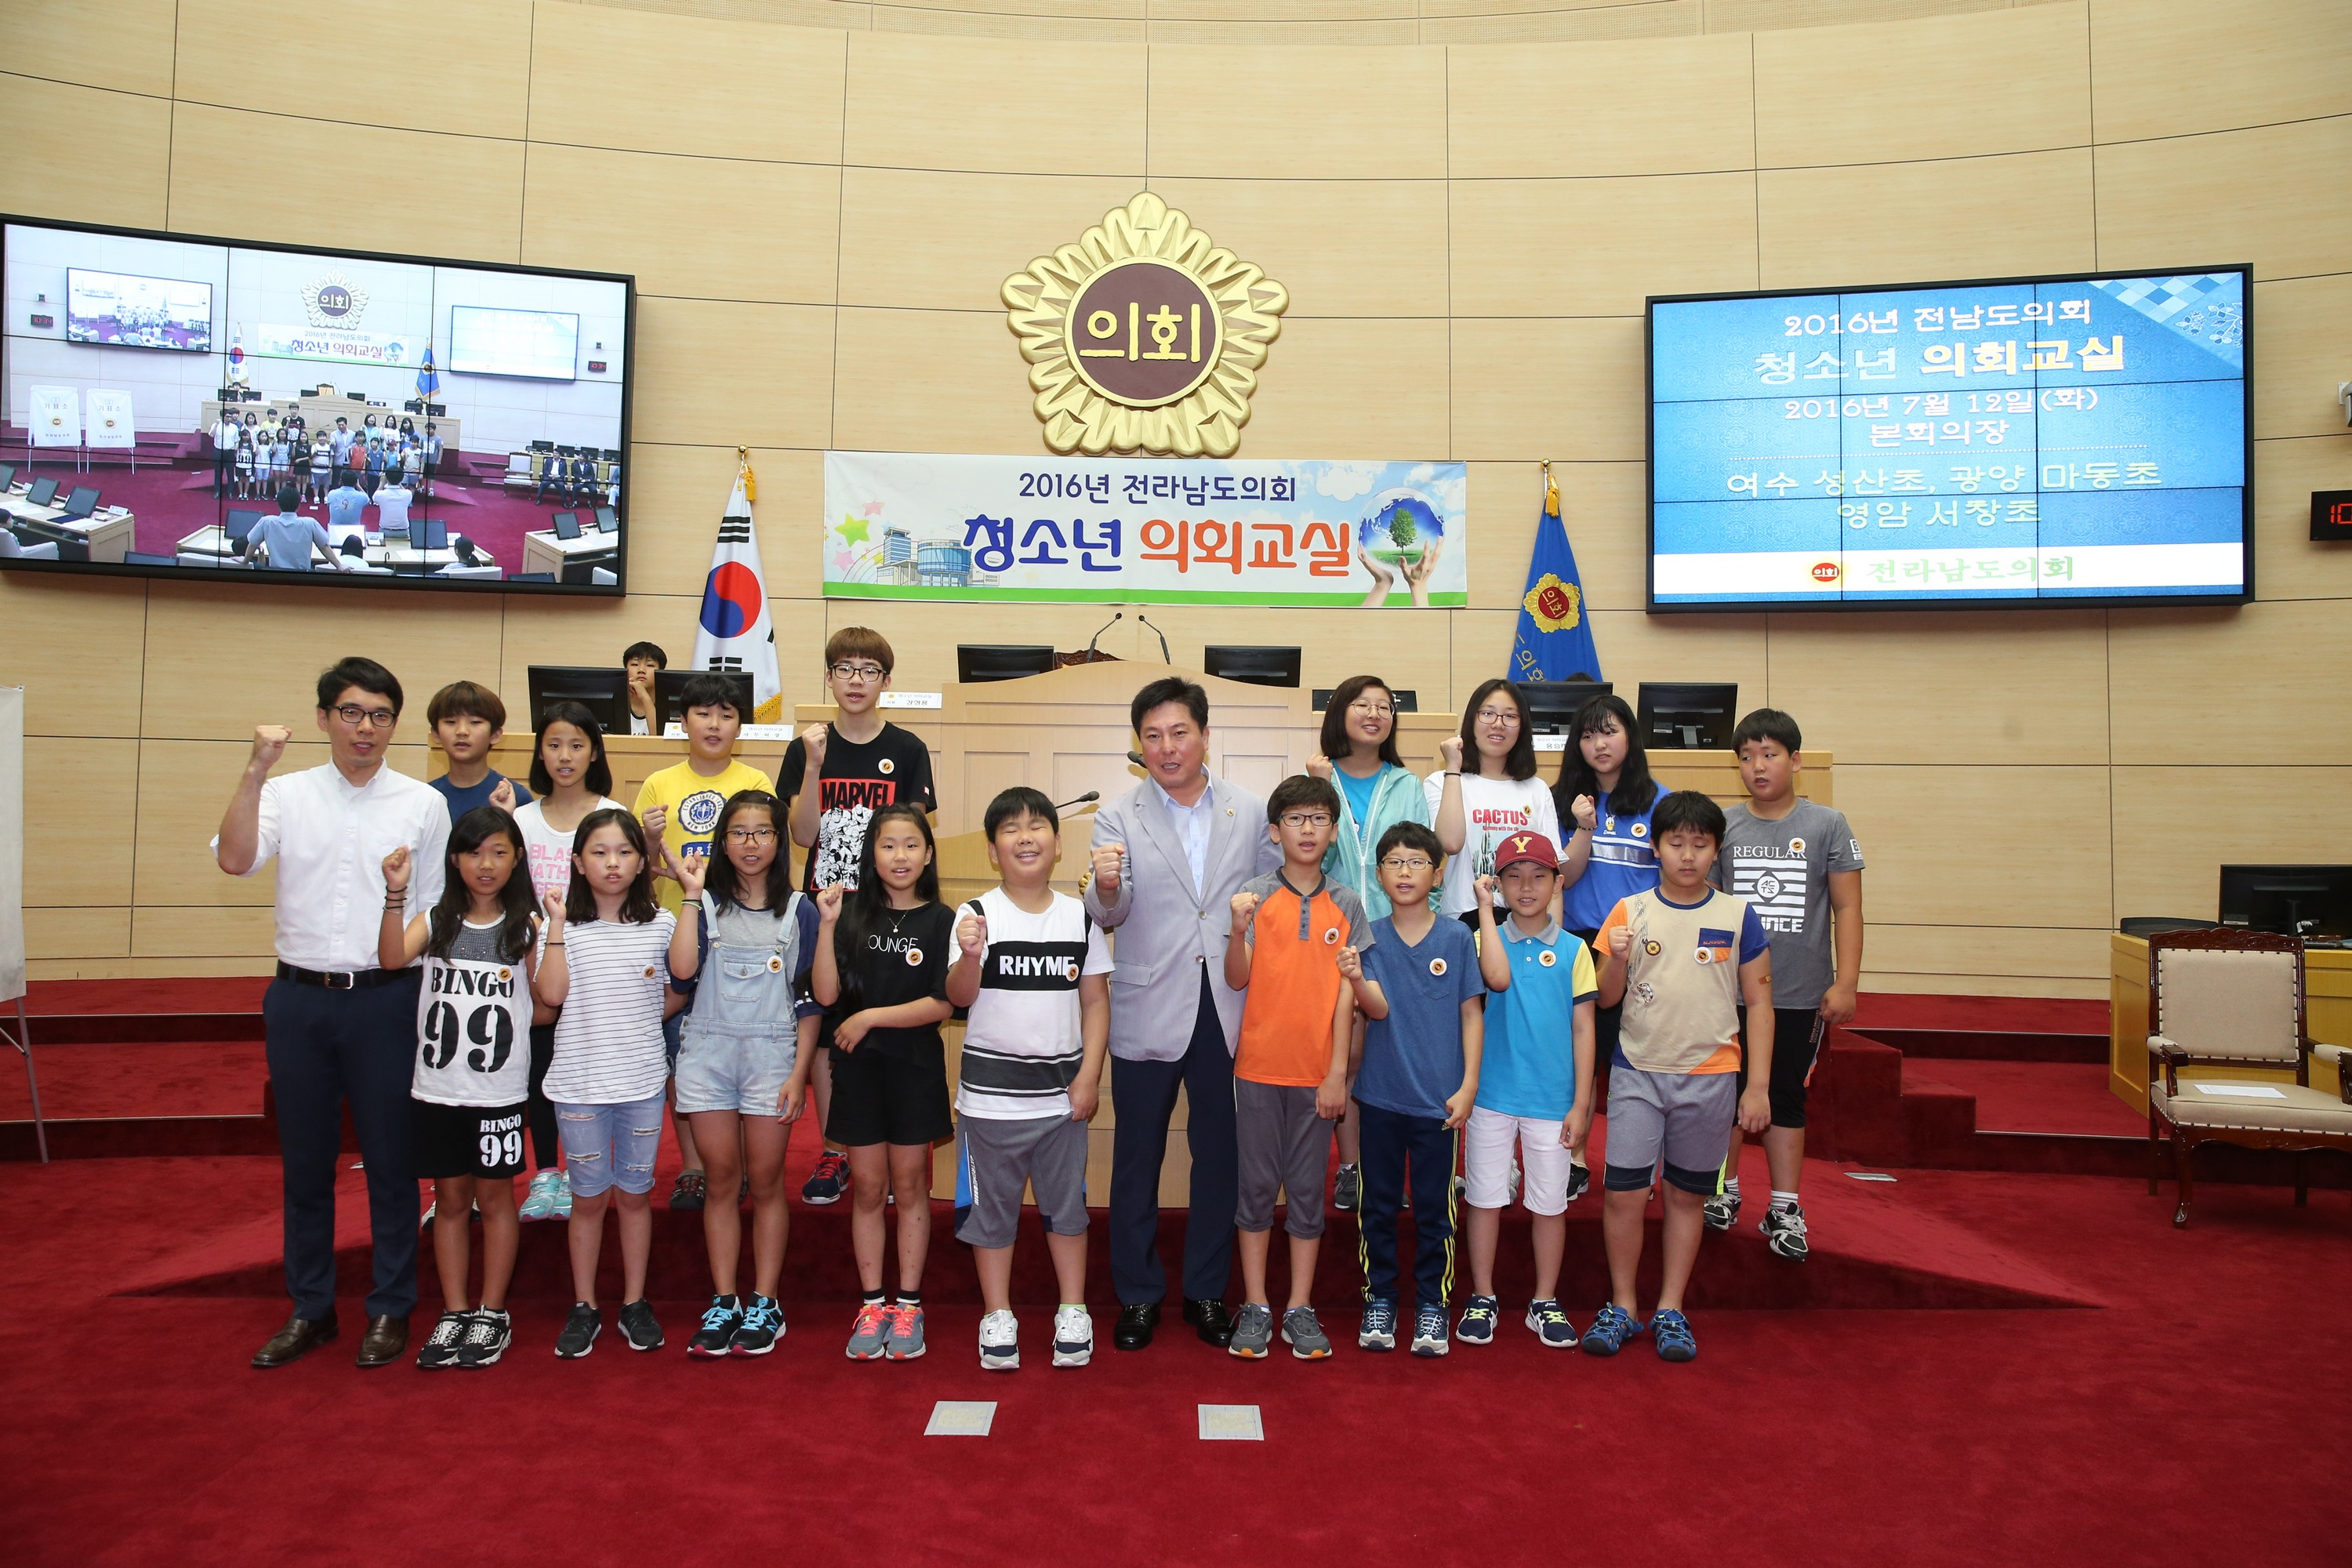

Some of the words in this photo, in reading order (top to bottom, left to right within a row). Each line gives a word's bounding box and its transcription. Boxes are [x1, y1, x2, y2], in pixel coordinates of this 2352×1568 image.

[319, 293, 349, 310] 의회
[1079, 302, 1201, 363] 의회
[1783, 308, 1899, 337] 2016년
[1913, 299, 2091, 332] 전남도의회
[292, 339, 329, 354] 청소년
[332, 342, 383, 359] 의회교실
[304, 330, 326, 339] 2016년
[329, 332, 371, 342] 전라남도의회
[1754, 346, 1896, 385] 청소년
[1920, 335, 2125, 378] 의회교실
[1784, 394, 1889, 420] 2016년
[1902, 393, 1950, 417] 7월
[1867, 419, 2011, 448] 본회의장
[1019, 472, 1109, 504] 2016년
[1122, 474, 1295, 506] 전라남도의회
[1726, 471, 1800, 499] 여수
[1813, 468, 1936, 497] 성산초,
[1949, 464, 2027, 493] 광양
[2042, 462, 2162, 490] 마동초
[1836, 501, 1912, 529] 영암
[1925, 499, 2042, 527] 서창초
[963, 514, 1123, 572] 청소년
[1140, 519, 1350, 577] 의회교실
[1813, 567, 1838, 578] 의회
[1867, 556, 2073, 584] 전라남도의회
[1541, 590, 1566, 619] 의회
[687, 821, 699, 829] NEW
[701, 821, 716, 830] YORK
[1472, 808, 1528, 826] CACTUS
[1511, 836, 1533, 854] Y
[431, 967, 514, 998] BINGO
[423, 1000, 514, 1073] 99
[480, 1113, 521, 1133] BINGO
[480, 1131, 522, 1167] 99
